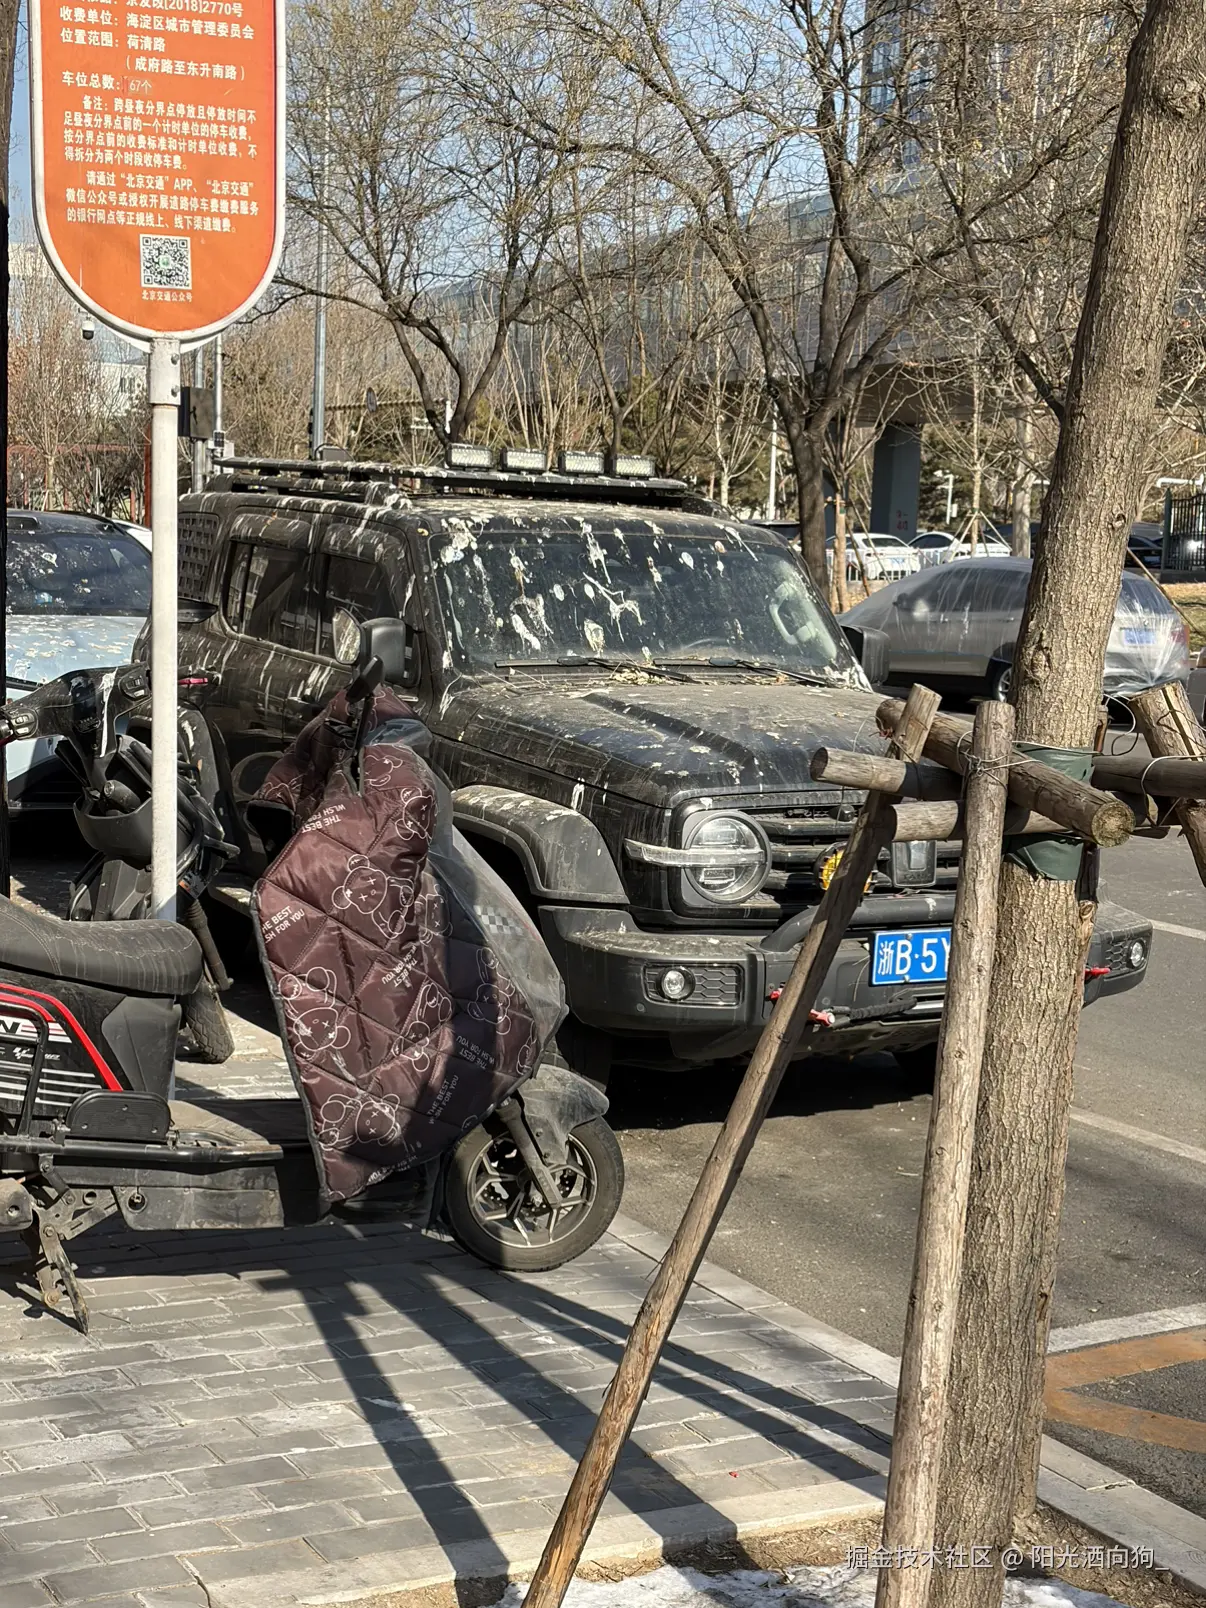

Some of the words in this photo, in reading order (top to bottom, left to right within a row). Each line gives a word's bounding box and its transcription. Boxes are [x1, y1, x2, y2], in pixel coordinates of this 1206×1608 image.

[141, 289, 193, 303] 北京交通公众号
[301, 820, 323, 834] BEST
[323, 814, 341, 827] THE
[262, 920, 273, 934] HE
[271, 905, 293, 925] BEST
[275, 920, 291, 934] FOR
[289, 908, 305, 923] YOU
[456, 1035, 469, 1048] YOU
[459, 1048, 476, 1062] BEST
[449, 1074, 459, 1089] YOU
